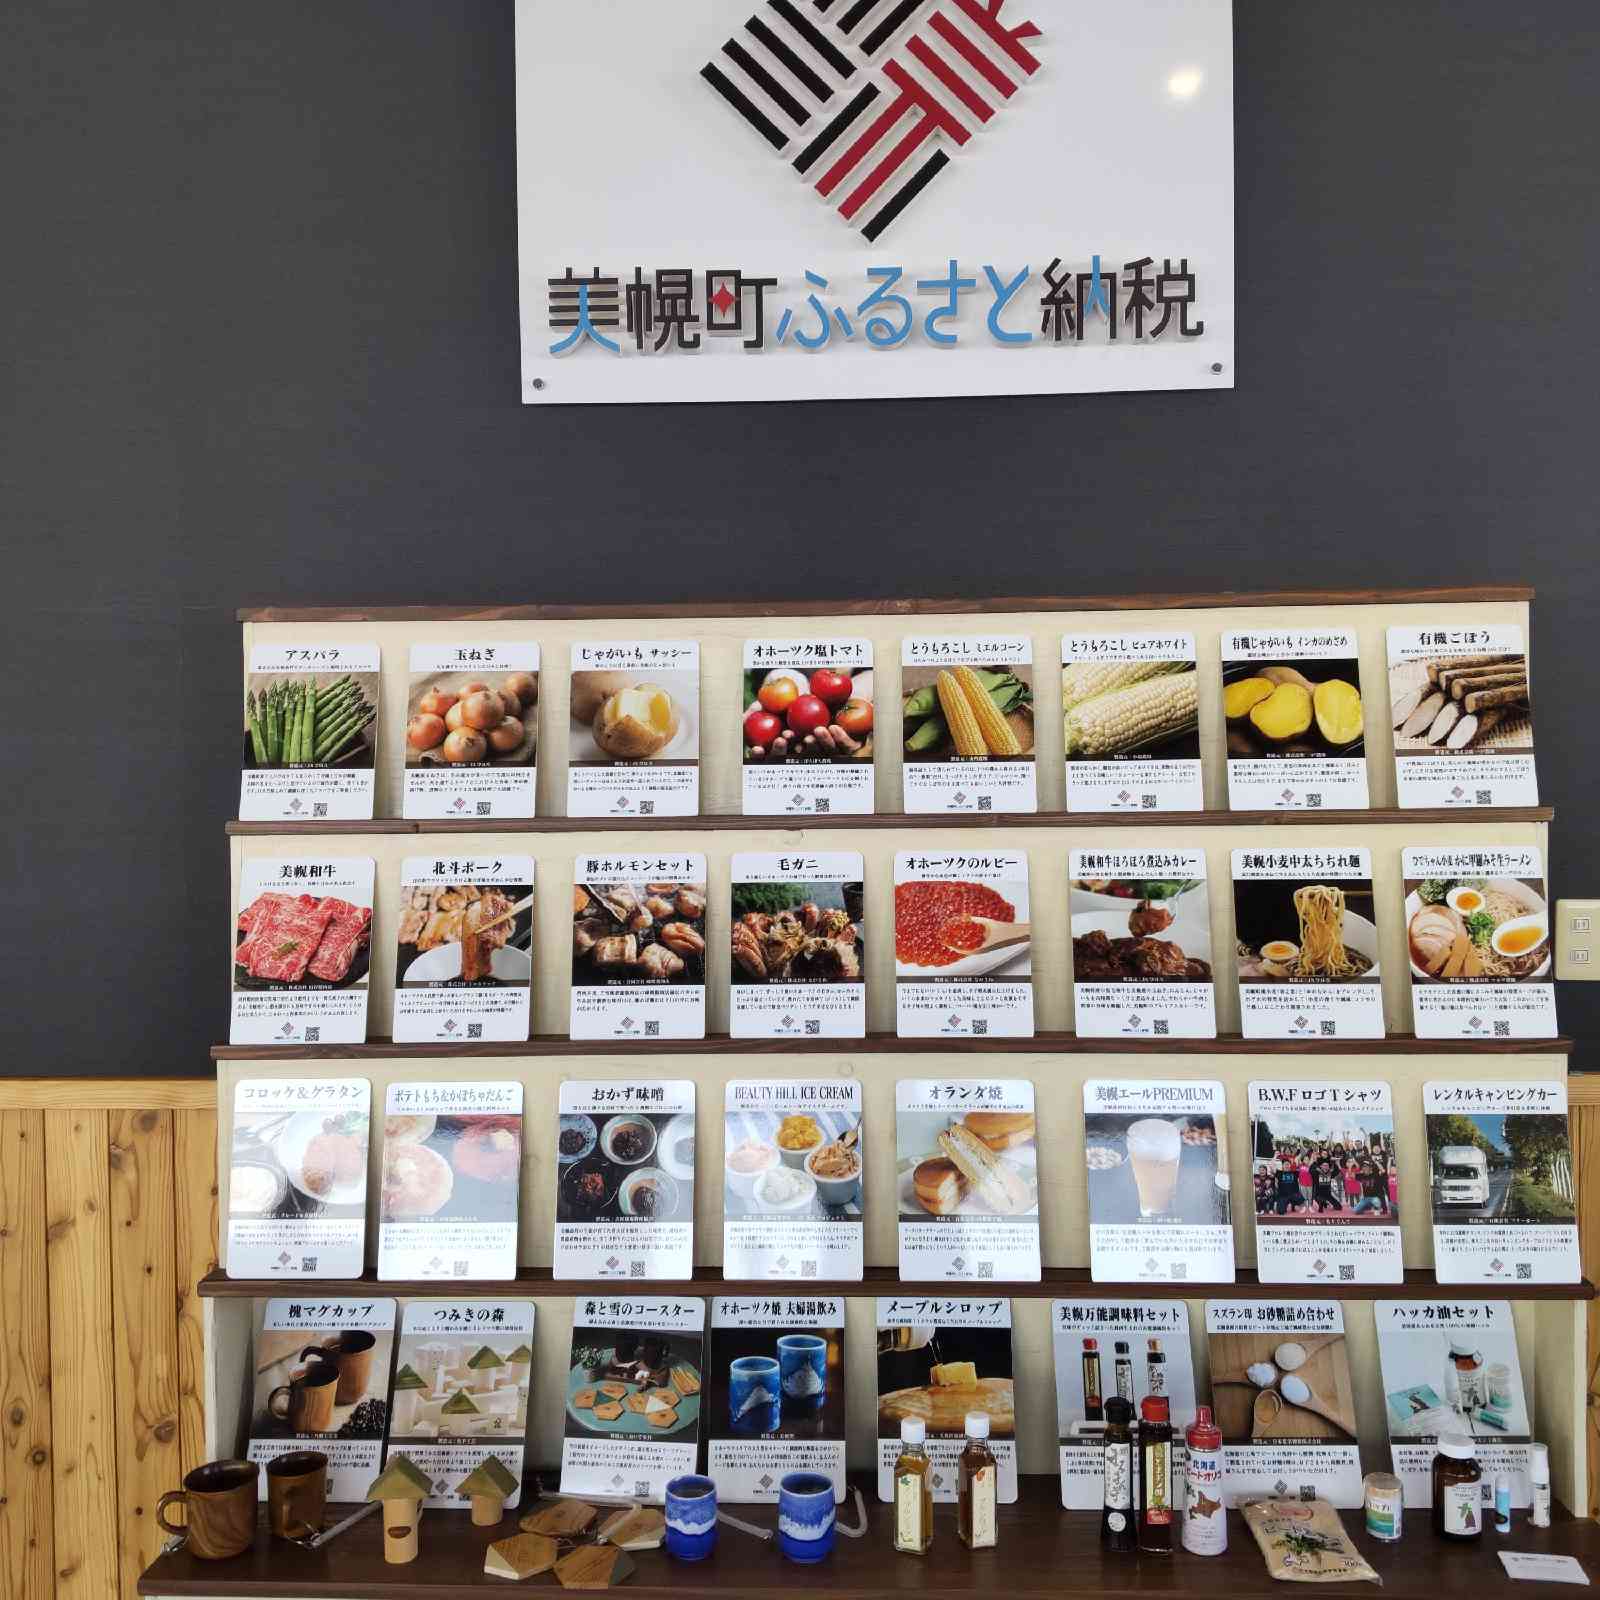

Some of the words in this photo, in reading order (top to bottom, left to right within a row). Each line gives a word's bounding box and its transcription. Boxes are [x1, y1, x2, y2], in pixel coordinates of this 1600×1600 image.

[548, 255, 1204, 355] 美幌町ふるさと納税
[1232, 636, 1293, 650] 有機じゃがいも
[1419, 630, 1490, 646] 有機ごぼう
[753, 644, 863, 658] オホーツク塩トマト
[911, 642, 970, 657] とうもろこし
[1070, 639, 1127, 653] とうもろこし
[285, 649, 340, 662] アスパラ
[458, 648, 496, 661] 玉ねぎ
[582, 647, 643, 661] じゃがいも
[432, 860, 503, 876] 北斗ポーク
[586, 859, 693, 874] 豚ホルモンセット
[777, 858, 819, 871] 毛ガニ
[905, 856, 1018, 870] オホーツクのルビー
[281, 864, 337, 879] 美幌和牛
[591, 1087, 664, 1102] おかず味噌
[735, 1086, 773, 1100] BEAUTY
[775, 1087, 798, 1100] HILL
[800, 1086, 817, 1100] ICE
[819, 1086, 853, 1100] CREAM
[929, 1085, 1003, 1100] オランダ焼
[1434, 1087, 1558, 1102] レンタルキャンピングカー
[434, 1307, 505, 1323] つみきの森
[584, 1300, 695, 1317] 森と雪のコースター
[720, 1301, 782, 1316] オホーツク焼
[887, 1300, 1003, 1316] メープルシロップ
[1061, 1306, 1180, 1323] 美幌万能調味料セット
[1393, 1305, 1494, 1320] ハッカ油セット
[1193, 1460, 1216, 1470] 北海道
